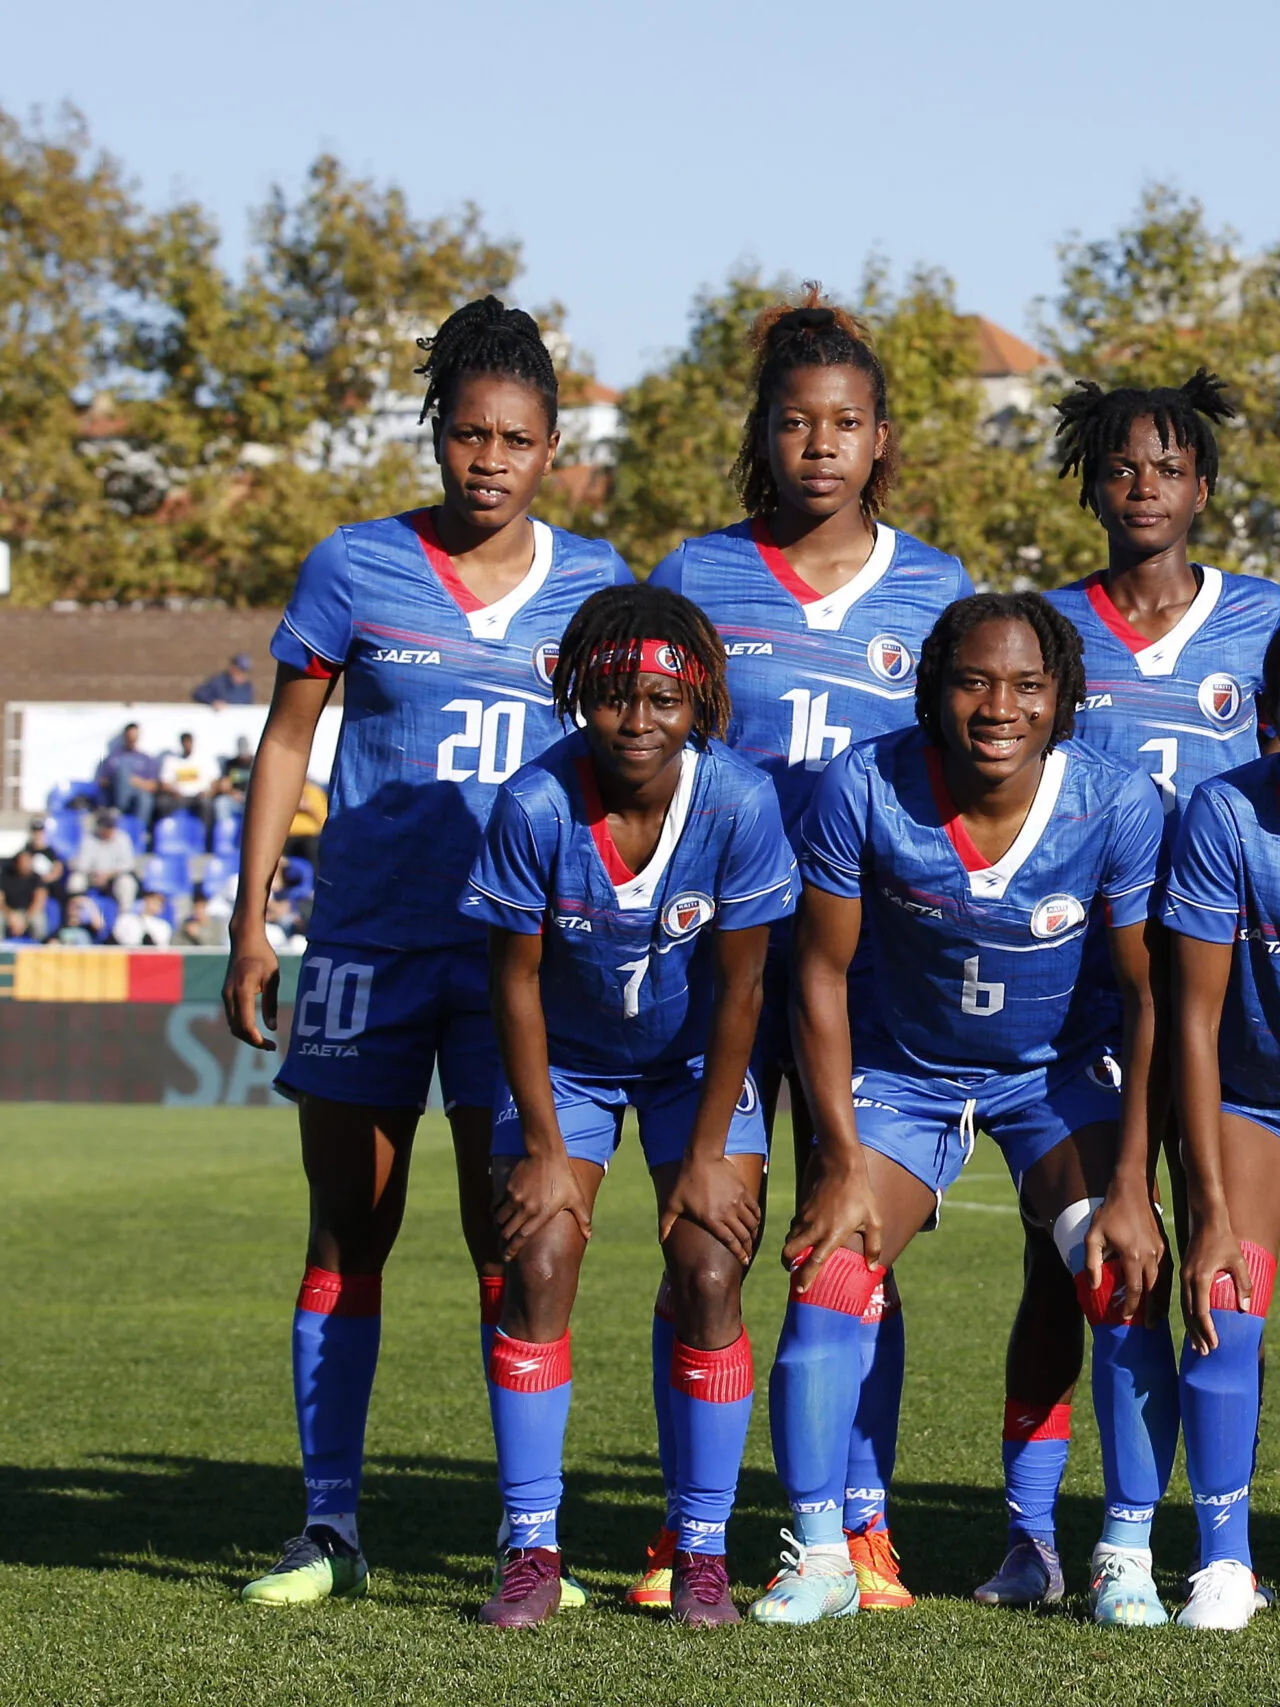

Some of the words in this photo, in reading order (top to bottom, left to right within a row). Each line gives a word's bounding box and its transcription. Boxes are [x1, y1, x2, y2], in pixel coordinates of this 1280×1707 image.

[372, 649, 441, 665] SAETA
[723, 642, 773, 656] AETA
[1075, 693, 1113, 712] ETA
[779, 688, 852, 772] 16
[437, 699, 526, 785] 20
[554, 916, 592, 933] ETA
[615, 953, 650, 1019] 7
[961, 954, 1005, 1017] 6
[296, 956, 375, 1041] 20
[163, 1005, 300, 1106] SA
[298, 1043, 360, 1057] SAETA
[1194, 1484, 1249, 1506] SAETA
[792, 1498, 838, 1515] AETA
